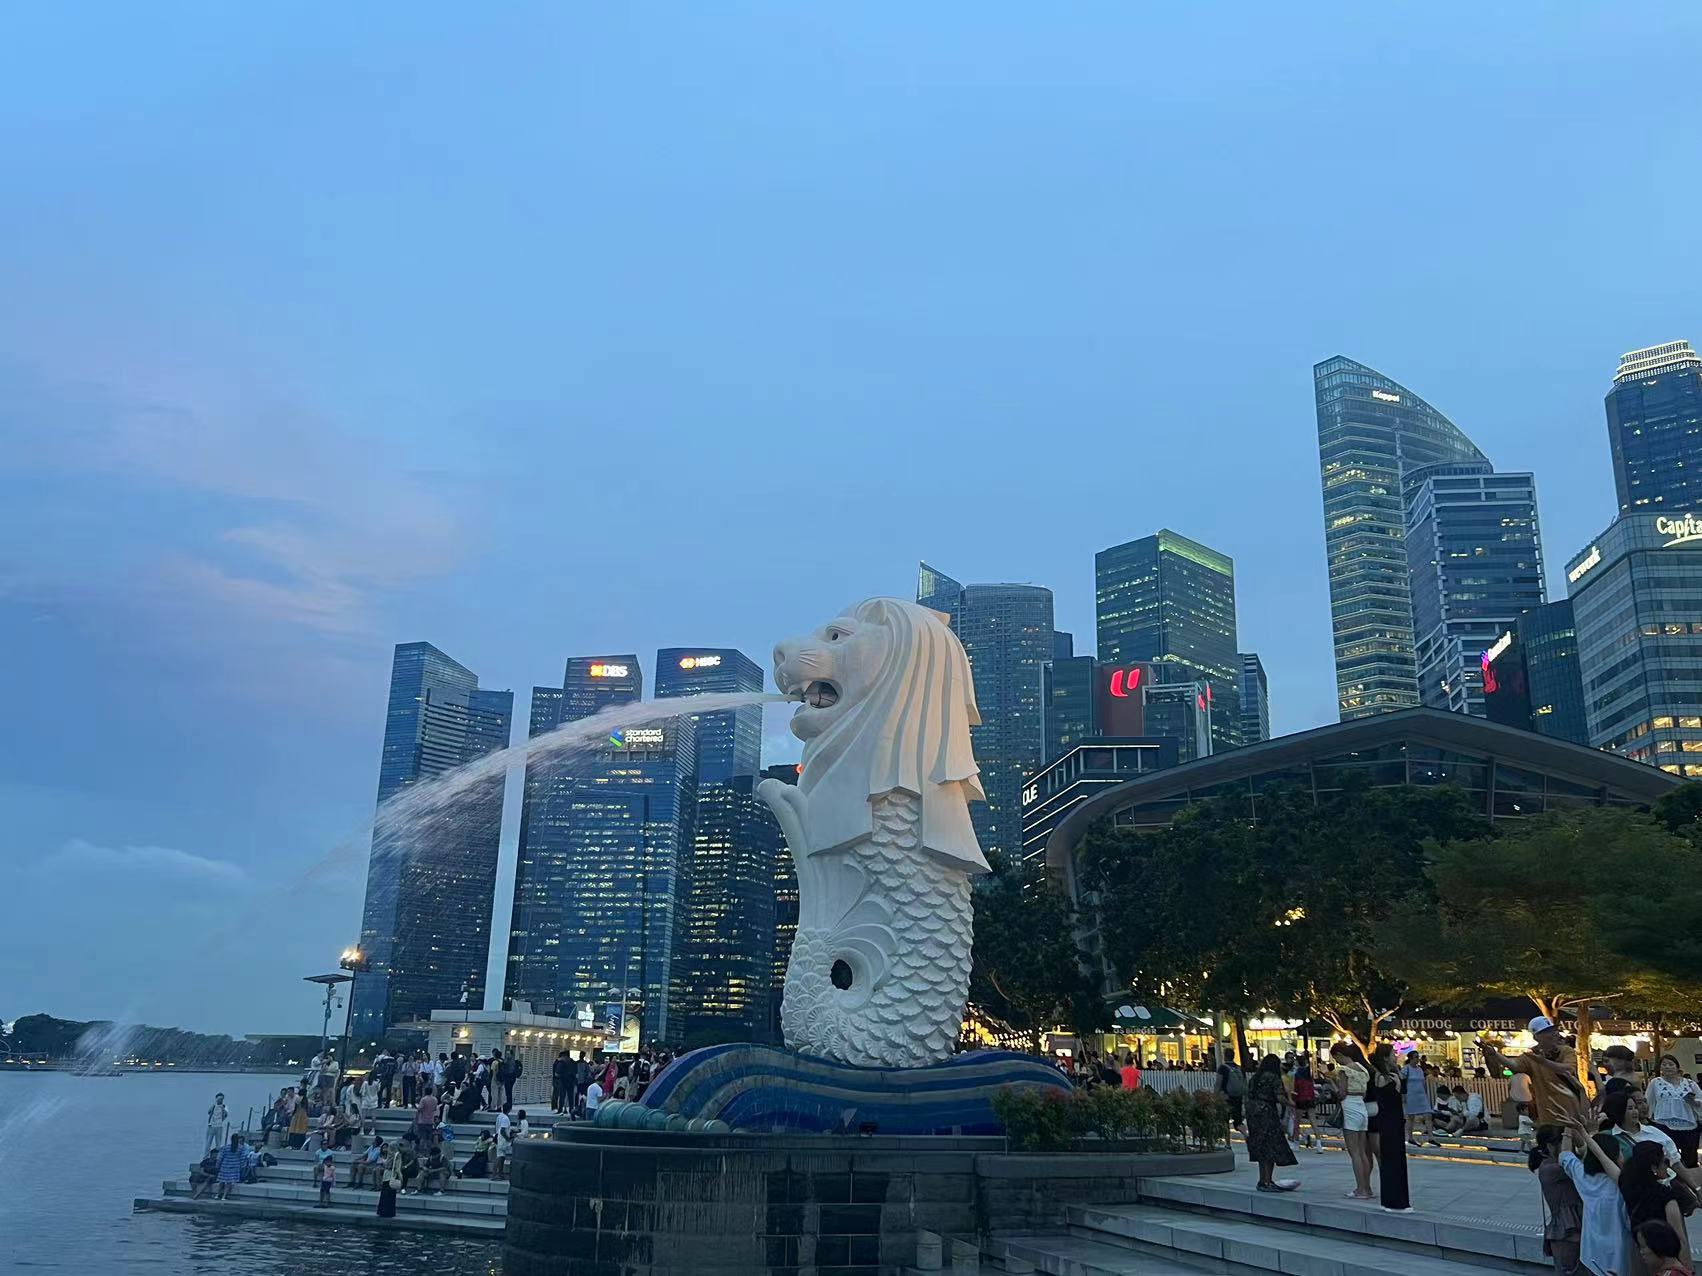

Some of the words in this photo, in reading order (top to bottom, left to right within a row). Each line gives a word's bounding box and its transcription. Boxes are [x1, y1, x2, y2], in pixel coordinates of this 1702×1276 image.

[696, 655, 722, 668] HSBC
[603, 664, 628, 678] DBS
[625, 728, 663, 737] standard
[624, 735, 664, 743] chartered
[1022, 784, 1038, 806] OUE
[1401, 1019, 1452, 1029] HOTDOG
[1469, 1019, 1516, 1030] COFFEE
